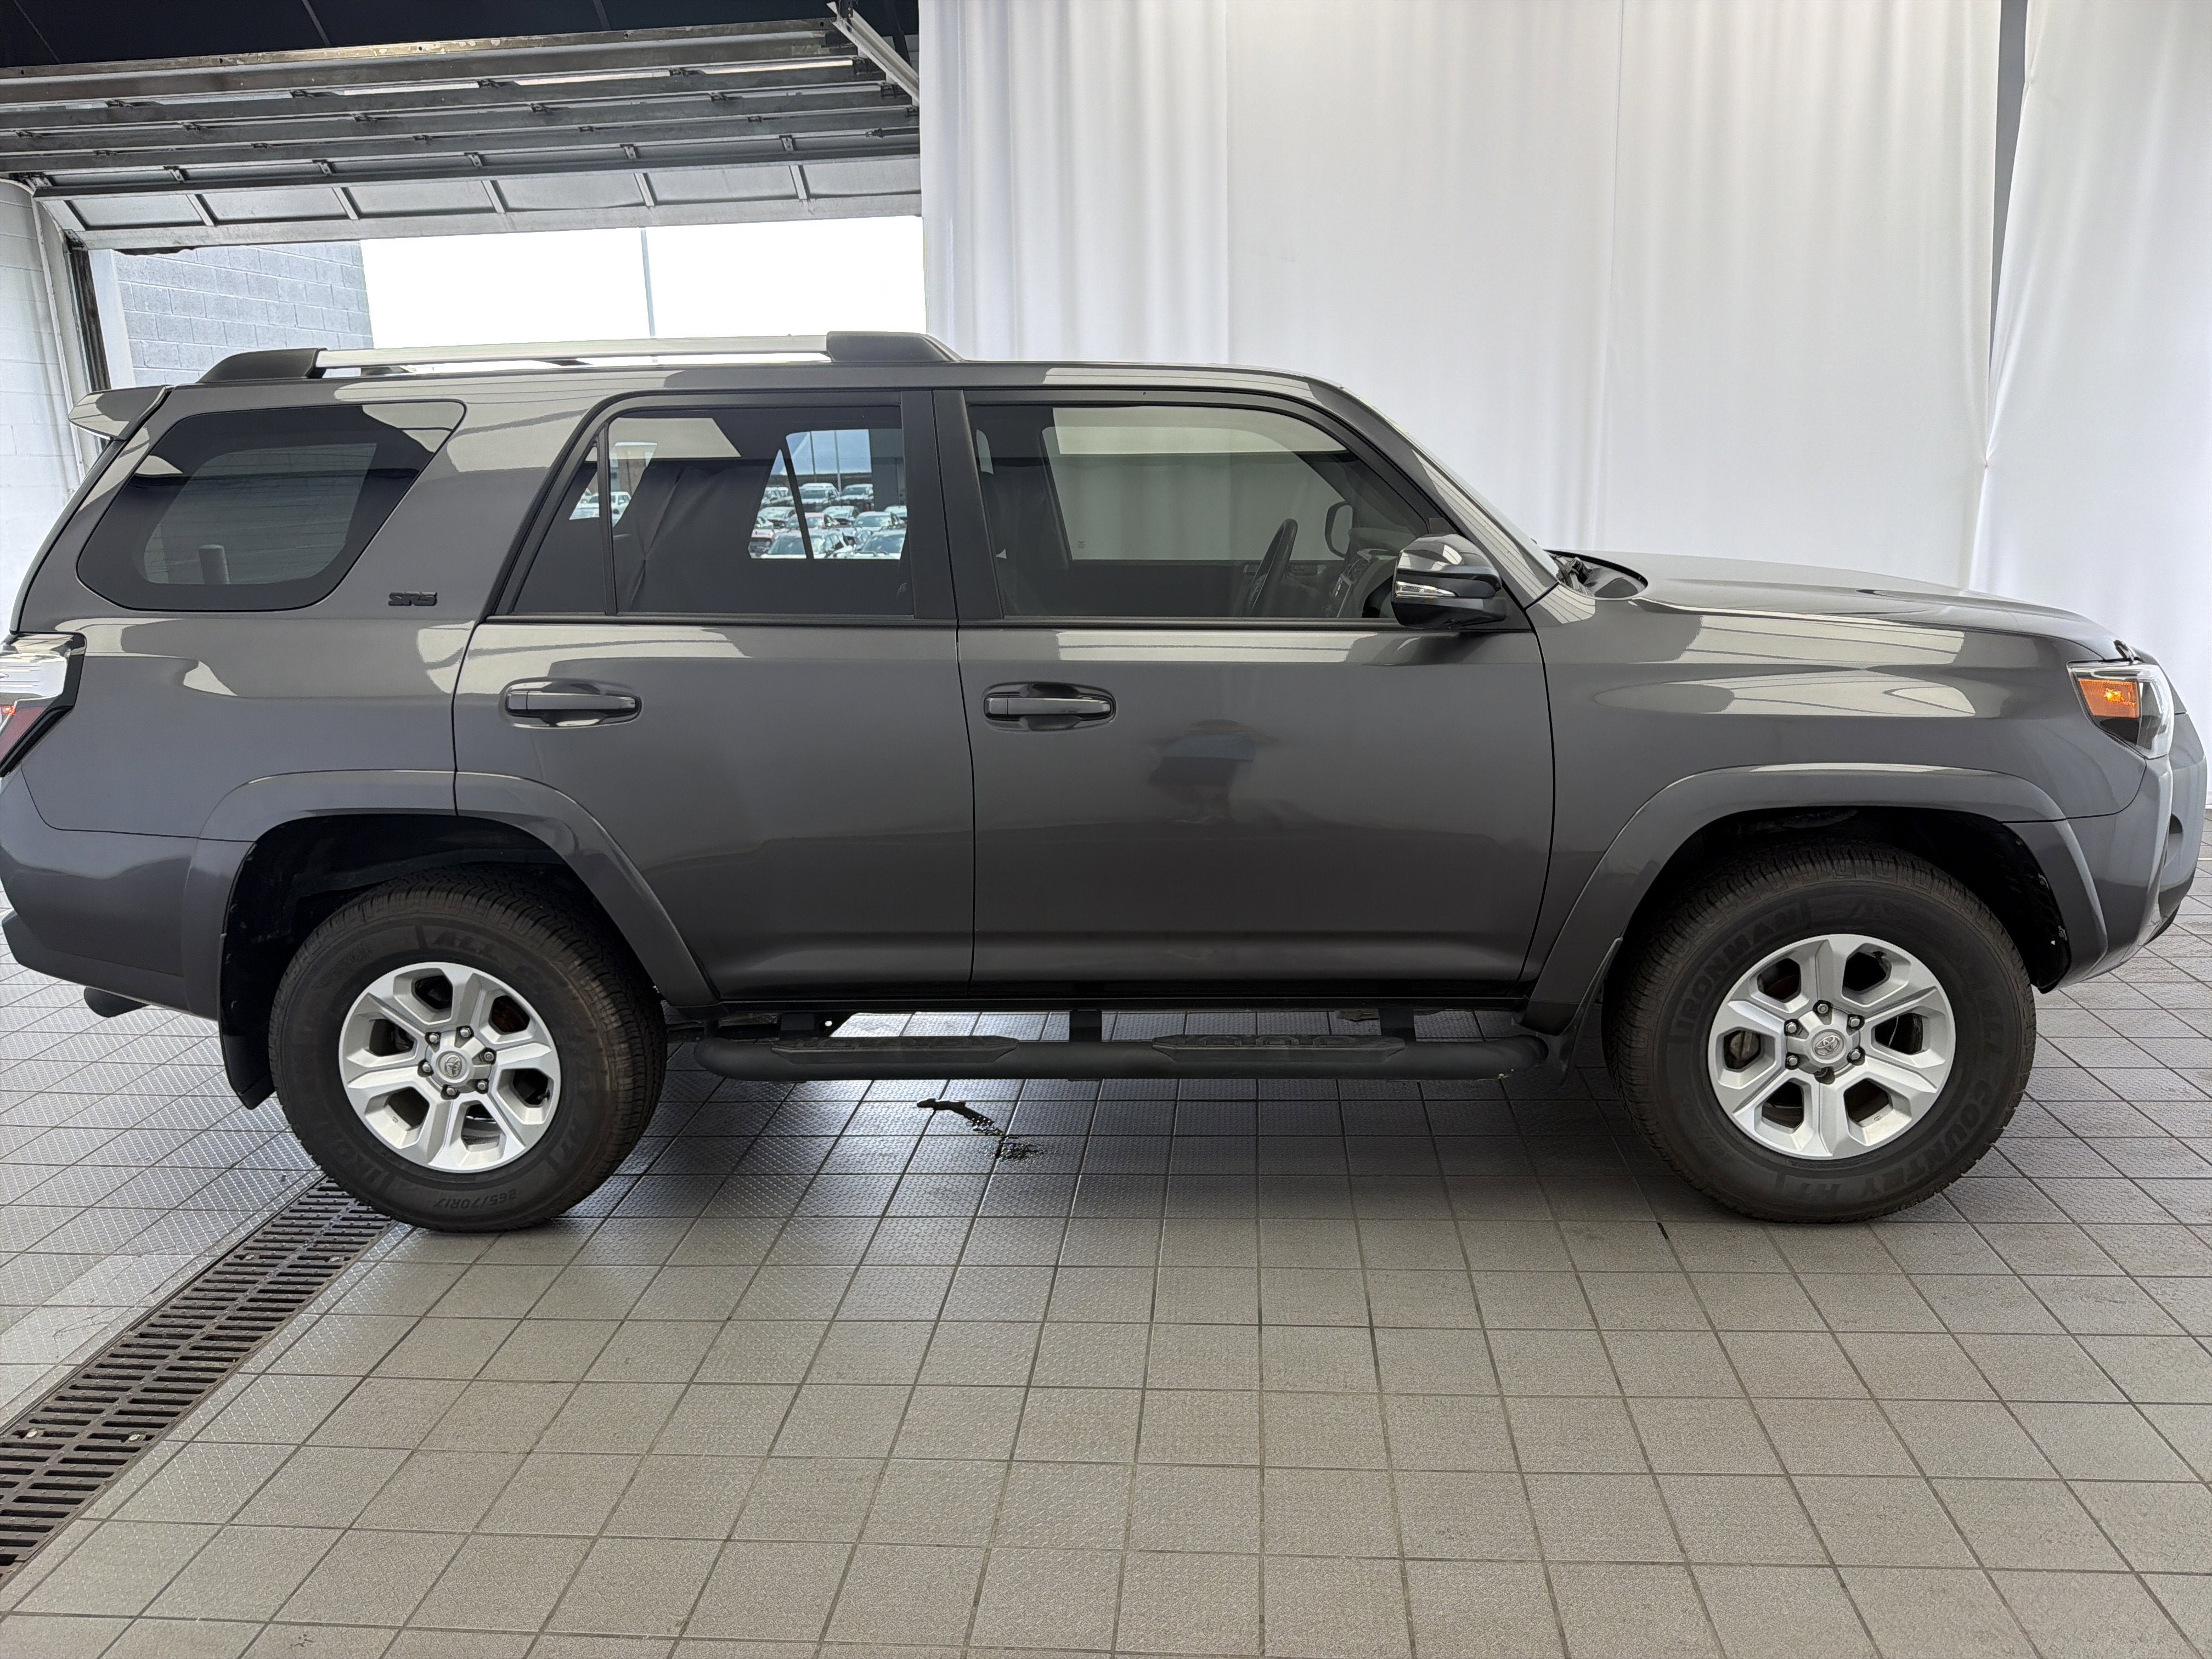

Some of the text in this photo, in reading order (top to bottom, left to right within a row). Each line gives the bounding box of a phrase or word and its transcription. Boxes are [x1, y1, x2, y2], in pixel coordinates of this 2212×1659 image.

[388, 591, 437, 606] SR5
[1675, 907, 1800, 1030] IRONMAN
[1855, 1078, 1998, 1200] COUNTRY
[432, 1186, 521, 1209] 265/70R17
